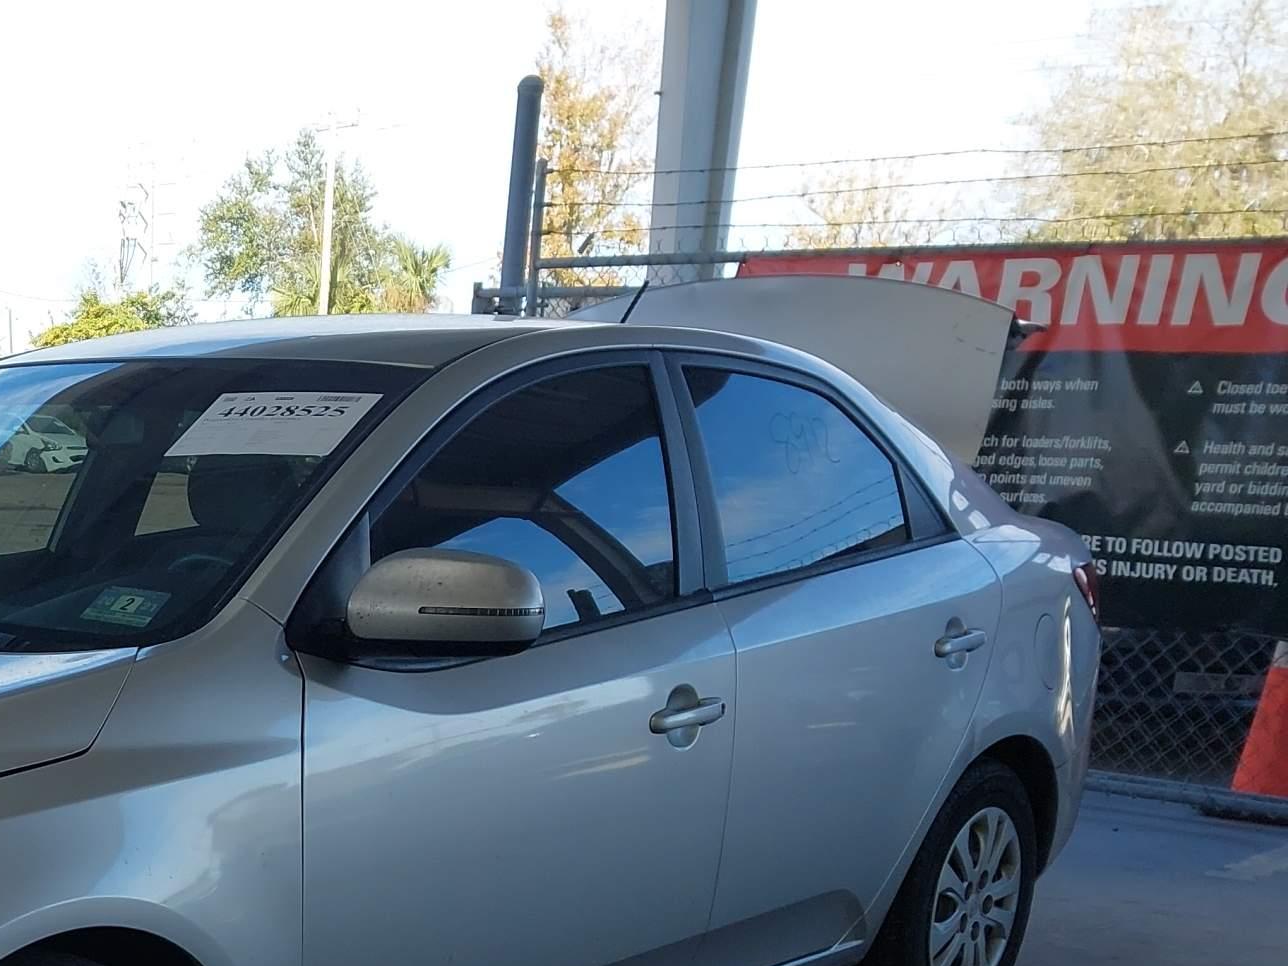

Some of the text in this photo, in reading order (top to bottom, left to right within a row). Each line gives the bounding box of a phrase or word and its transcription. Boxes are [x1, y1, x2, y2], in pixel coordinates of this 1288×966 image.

[1001, 377, 1099, 393] both ways when
[1217, 380, 1264, 394] Closed
[991, 395, 1017, 412] sing
[1213, 403, 1246, 415] must
[1249, 401, 1266, 415] be
[217, 405, 350, 418] 44028525
[1002, 435, 1020, 448] for
[1203, 441, 1246, 455] Health
[1248, 442, 1275, 456] and
[1038, 454, 1067, 467] loose
[1069, 457, 1104, 470] parts,
[1199, 461, 1241, 476] permit
[989, 471, 1026, 485] points
[1030, 472, 1049, 484] and
[1049, 476, 1092, 487] uneven
[1194, 481, 1226, 496] yard
[1229, 483, 1245, 495] or
[1191, 500, 1281, 516] accompanied
[1081, 534, 1283, 564] RE TO FOLLOW POSTED
[1112, 561, 1177, 581] INJURY
[1182, 565, 1208, 582] OR
[119, 597, 136, 611] 2
